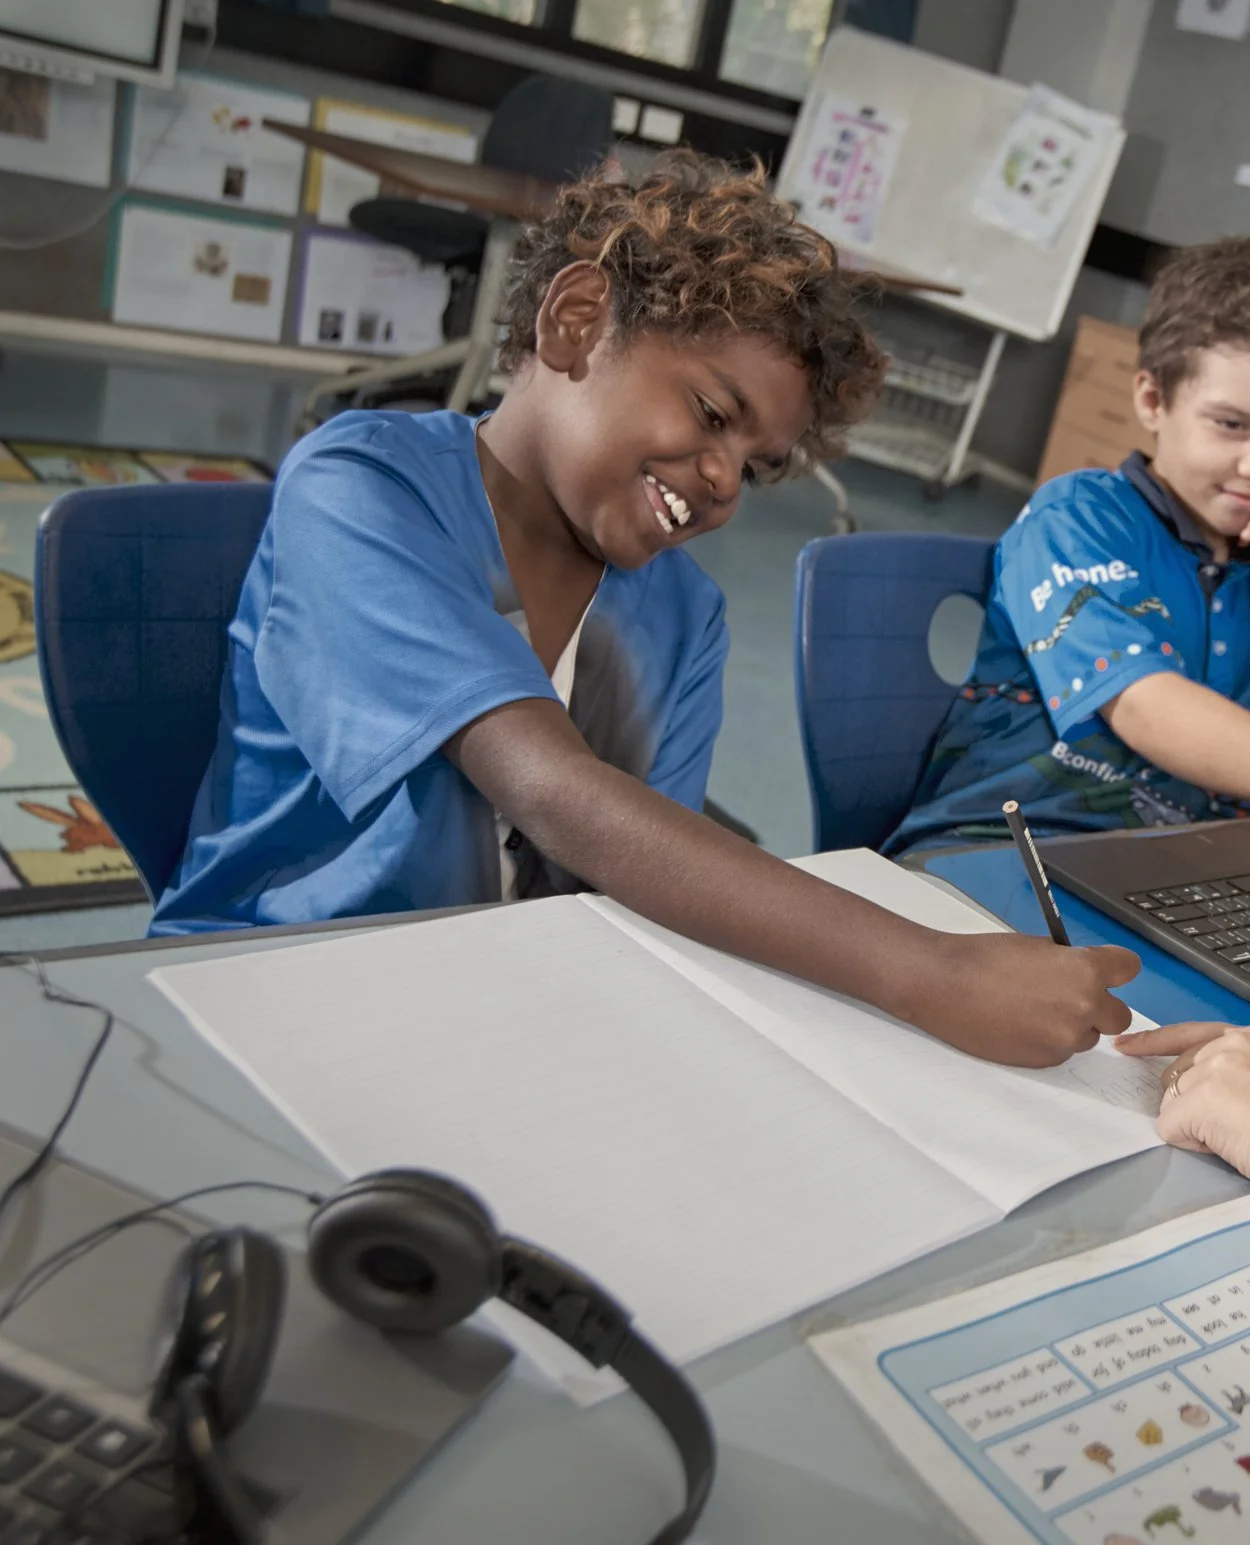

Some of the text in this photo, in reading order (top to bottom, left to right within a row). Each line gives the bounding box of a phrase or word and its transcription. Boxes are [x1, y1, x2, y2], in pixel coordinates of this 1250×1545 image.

[1030, 579, 1053, 612] Be
[1228, 1285, 1243, 1295] in
[1182, 1304, 1200, 1316] see
[1229, 1310, 1247, 1320] he
[1201, 1319, 1228, 1334] look
